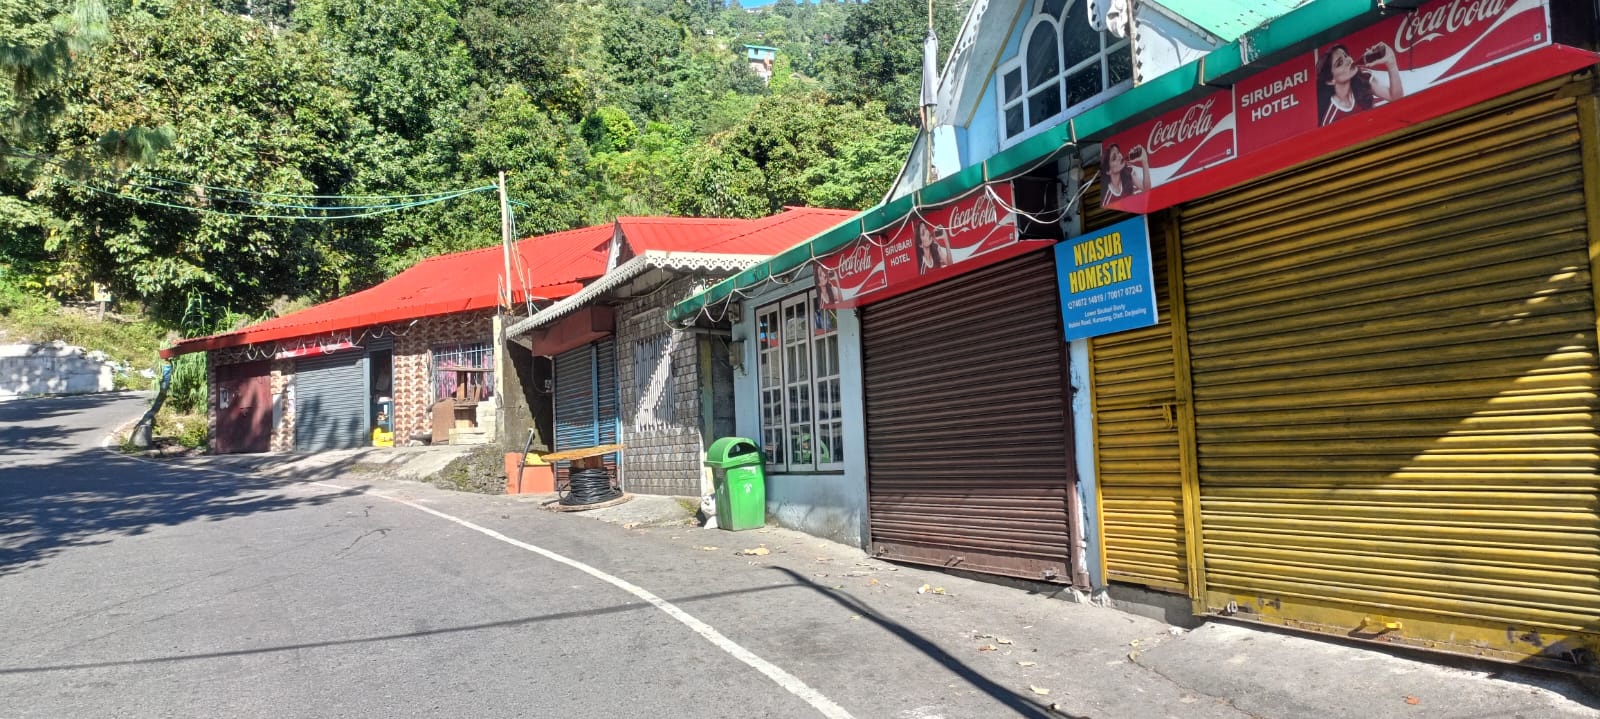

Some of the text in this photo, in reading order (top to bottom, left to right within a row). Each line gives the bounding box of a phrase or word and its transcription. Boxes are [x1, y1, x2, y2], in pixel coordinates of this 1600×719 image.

[1240, 69, 1310, 108] SIRUBARI
[1251, 93, 1300, 122] HOTEL
[1147, 97, 1216, 154] Coca-Cola
[885, 238, 913, 257] SIRUBARI
[890, 253, 911, 267] HOTEL
[1074, 232, 1122, 266] NYASUR
[1069, 256, 1132, 293] HOMESTAY
